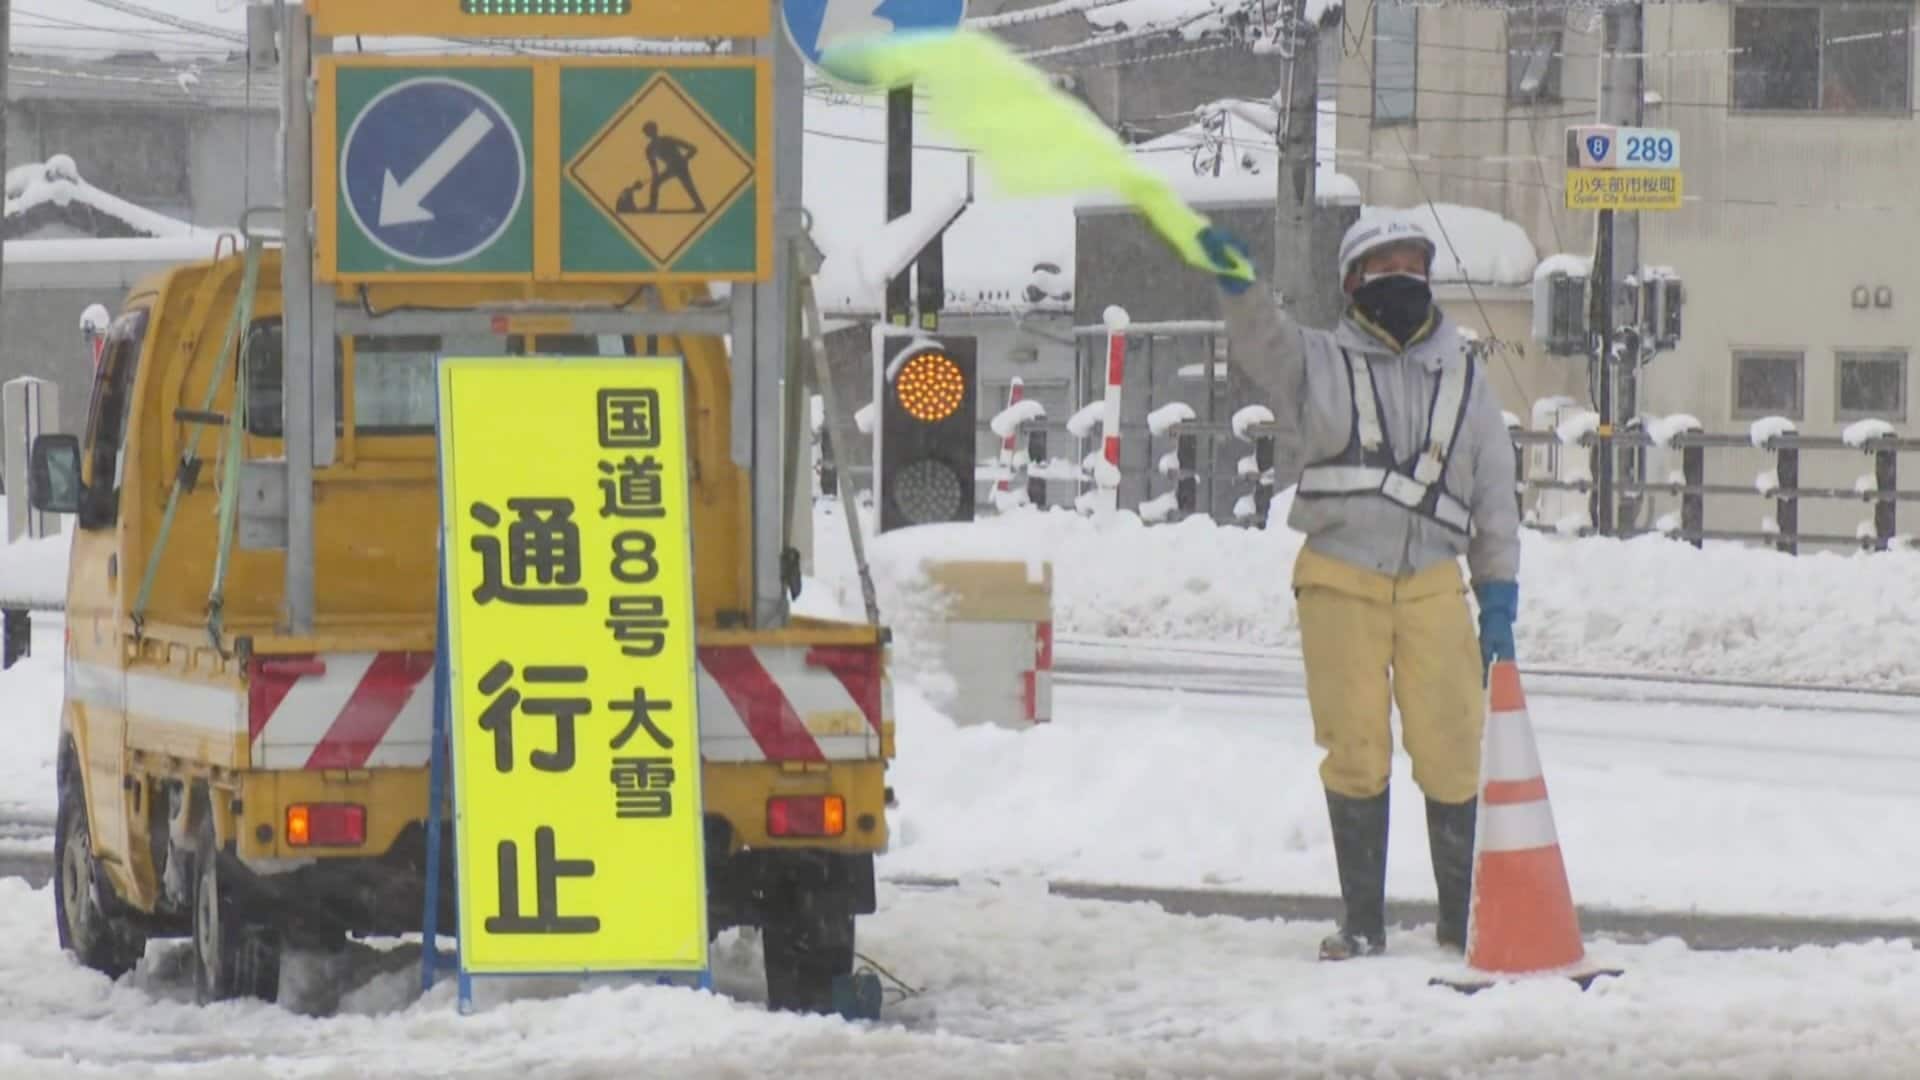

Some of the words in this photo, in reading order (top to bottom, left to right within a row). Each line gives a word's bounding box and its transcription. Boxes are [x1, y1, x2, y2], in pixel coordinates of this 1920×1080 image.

[1574, 176, 1676, 193] 小矢部市桜町
[1593, 137, 1603, 154] 8
[1626, 136, 1673, 162] 289
[597, 387, 669, 658] 国道8号
[470, 496, 601, 935] 通行止
[608, 686, 676, 819] 大雪
